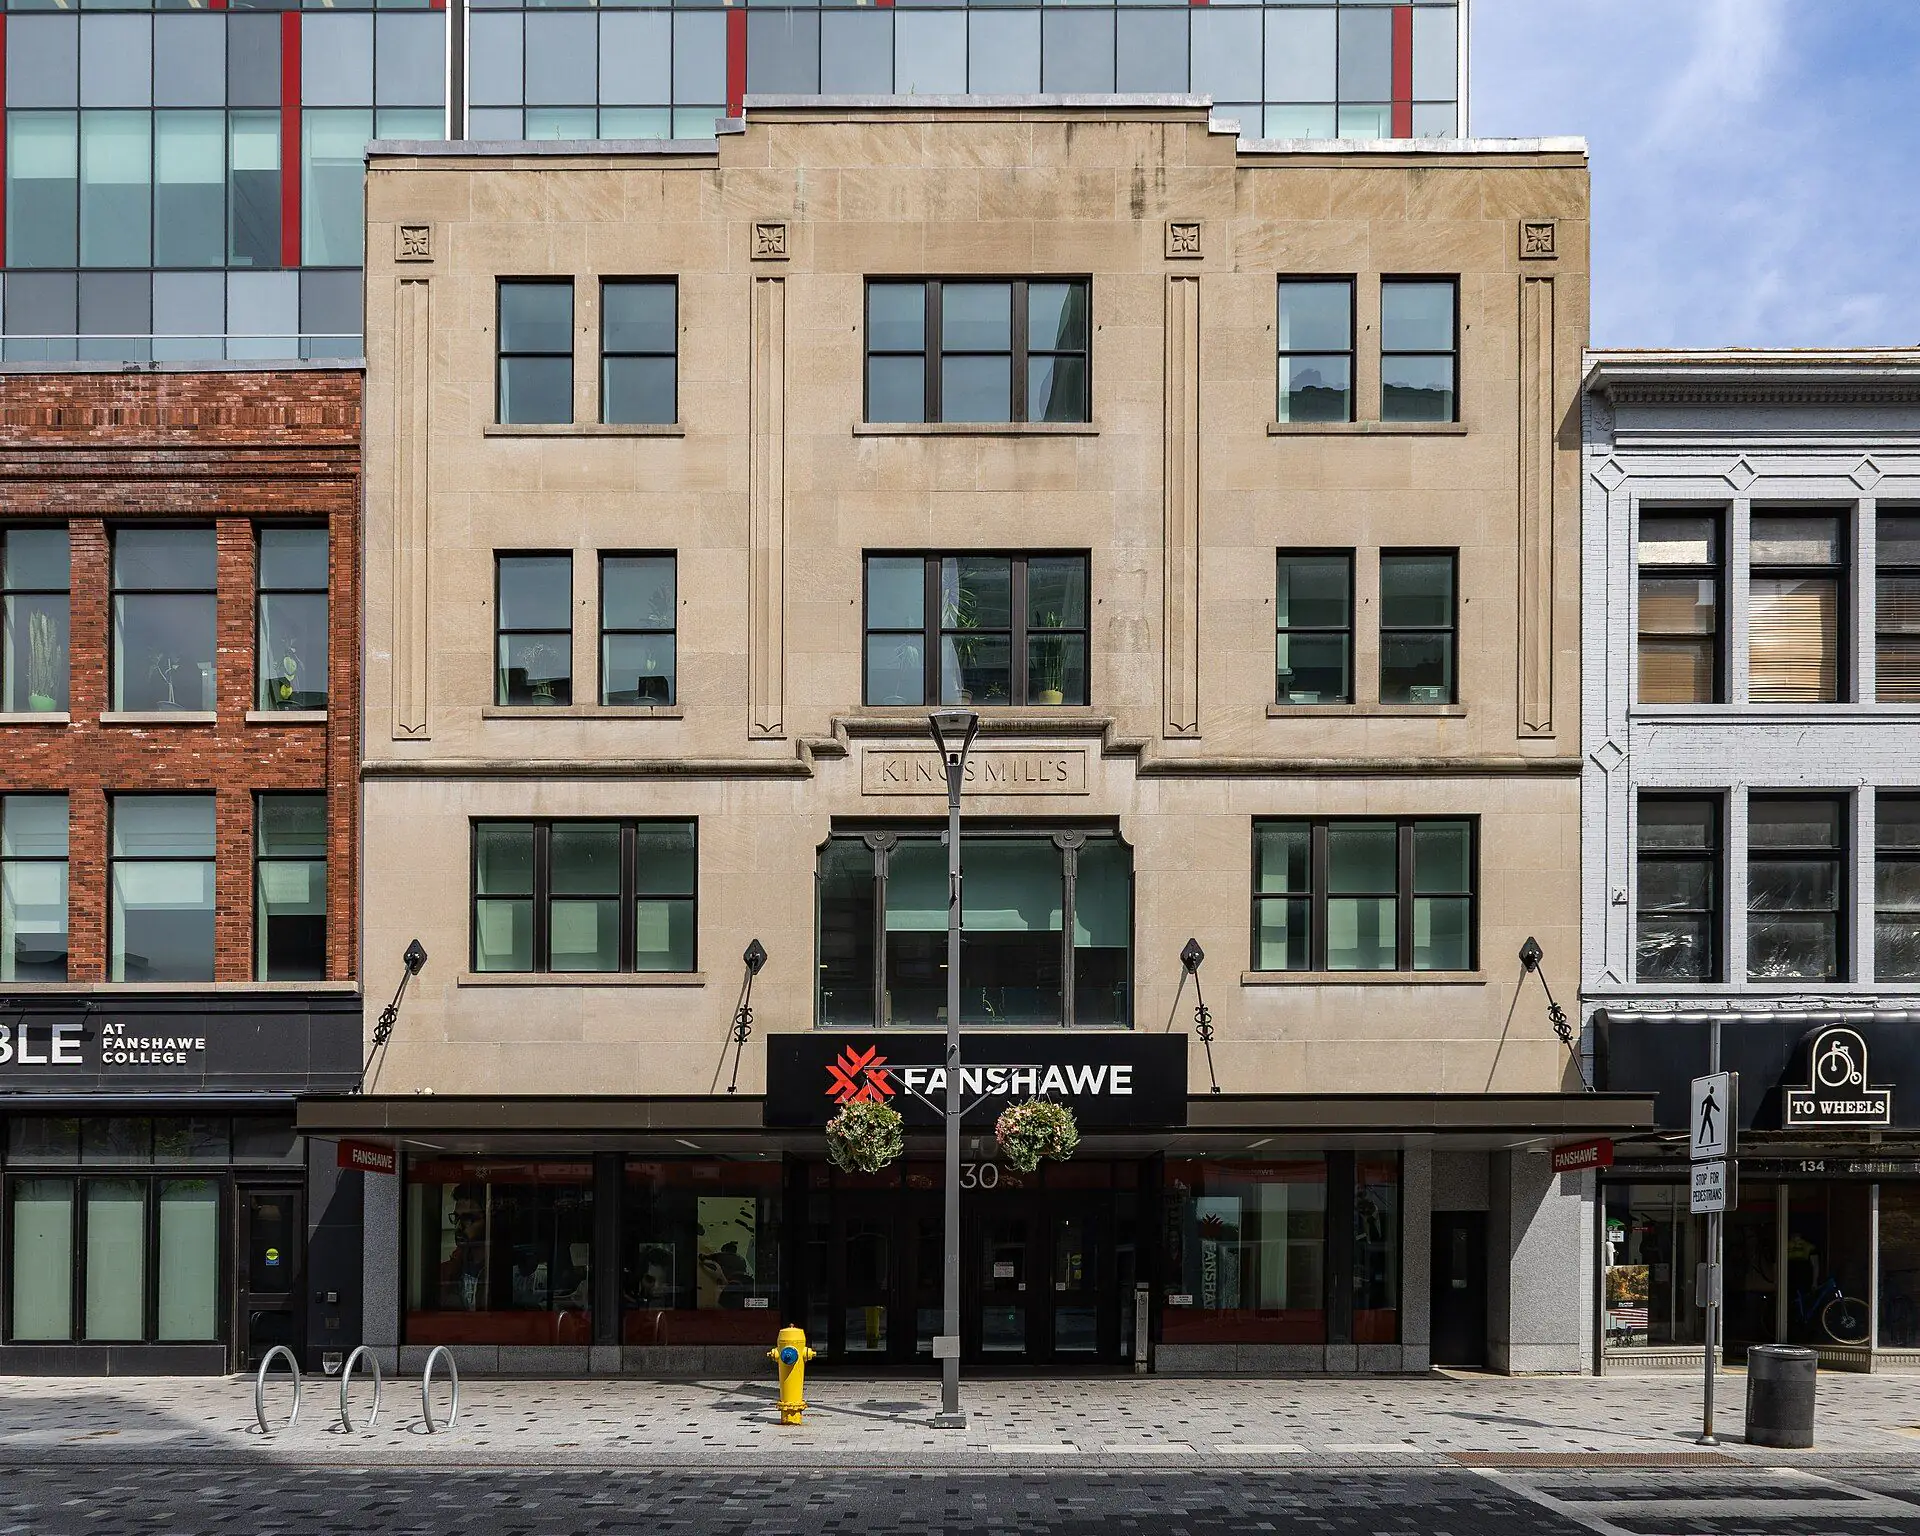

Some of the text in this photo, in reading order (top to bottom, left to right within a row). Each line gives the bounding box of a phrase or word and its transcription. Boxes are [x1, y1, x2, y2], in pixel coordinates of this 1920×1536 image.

[102, 1023, 125, 1035] AT
[102, 1037, 205, 1049] FANSHAWE
[102, 1052, 187, 1064] COLLEGE
[904, 1064, 1133, 1095] FANSHAWE
[1793, 1100, 1885, 1115] TO WHEELS
[352, 1148, 393, 1169] FANSHAWE
[1555, 1146, 1598, 1167] FANSHAWE
[1799, 1160, 1825, 1172] 134
[1695, 1171, 1720, 1186] STOP FOR
[1692, 1187, 1723, 1203] PEDESTRIANS
